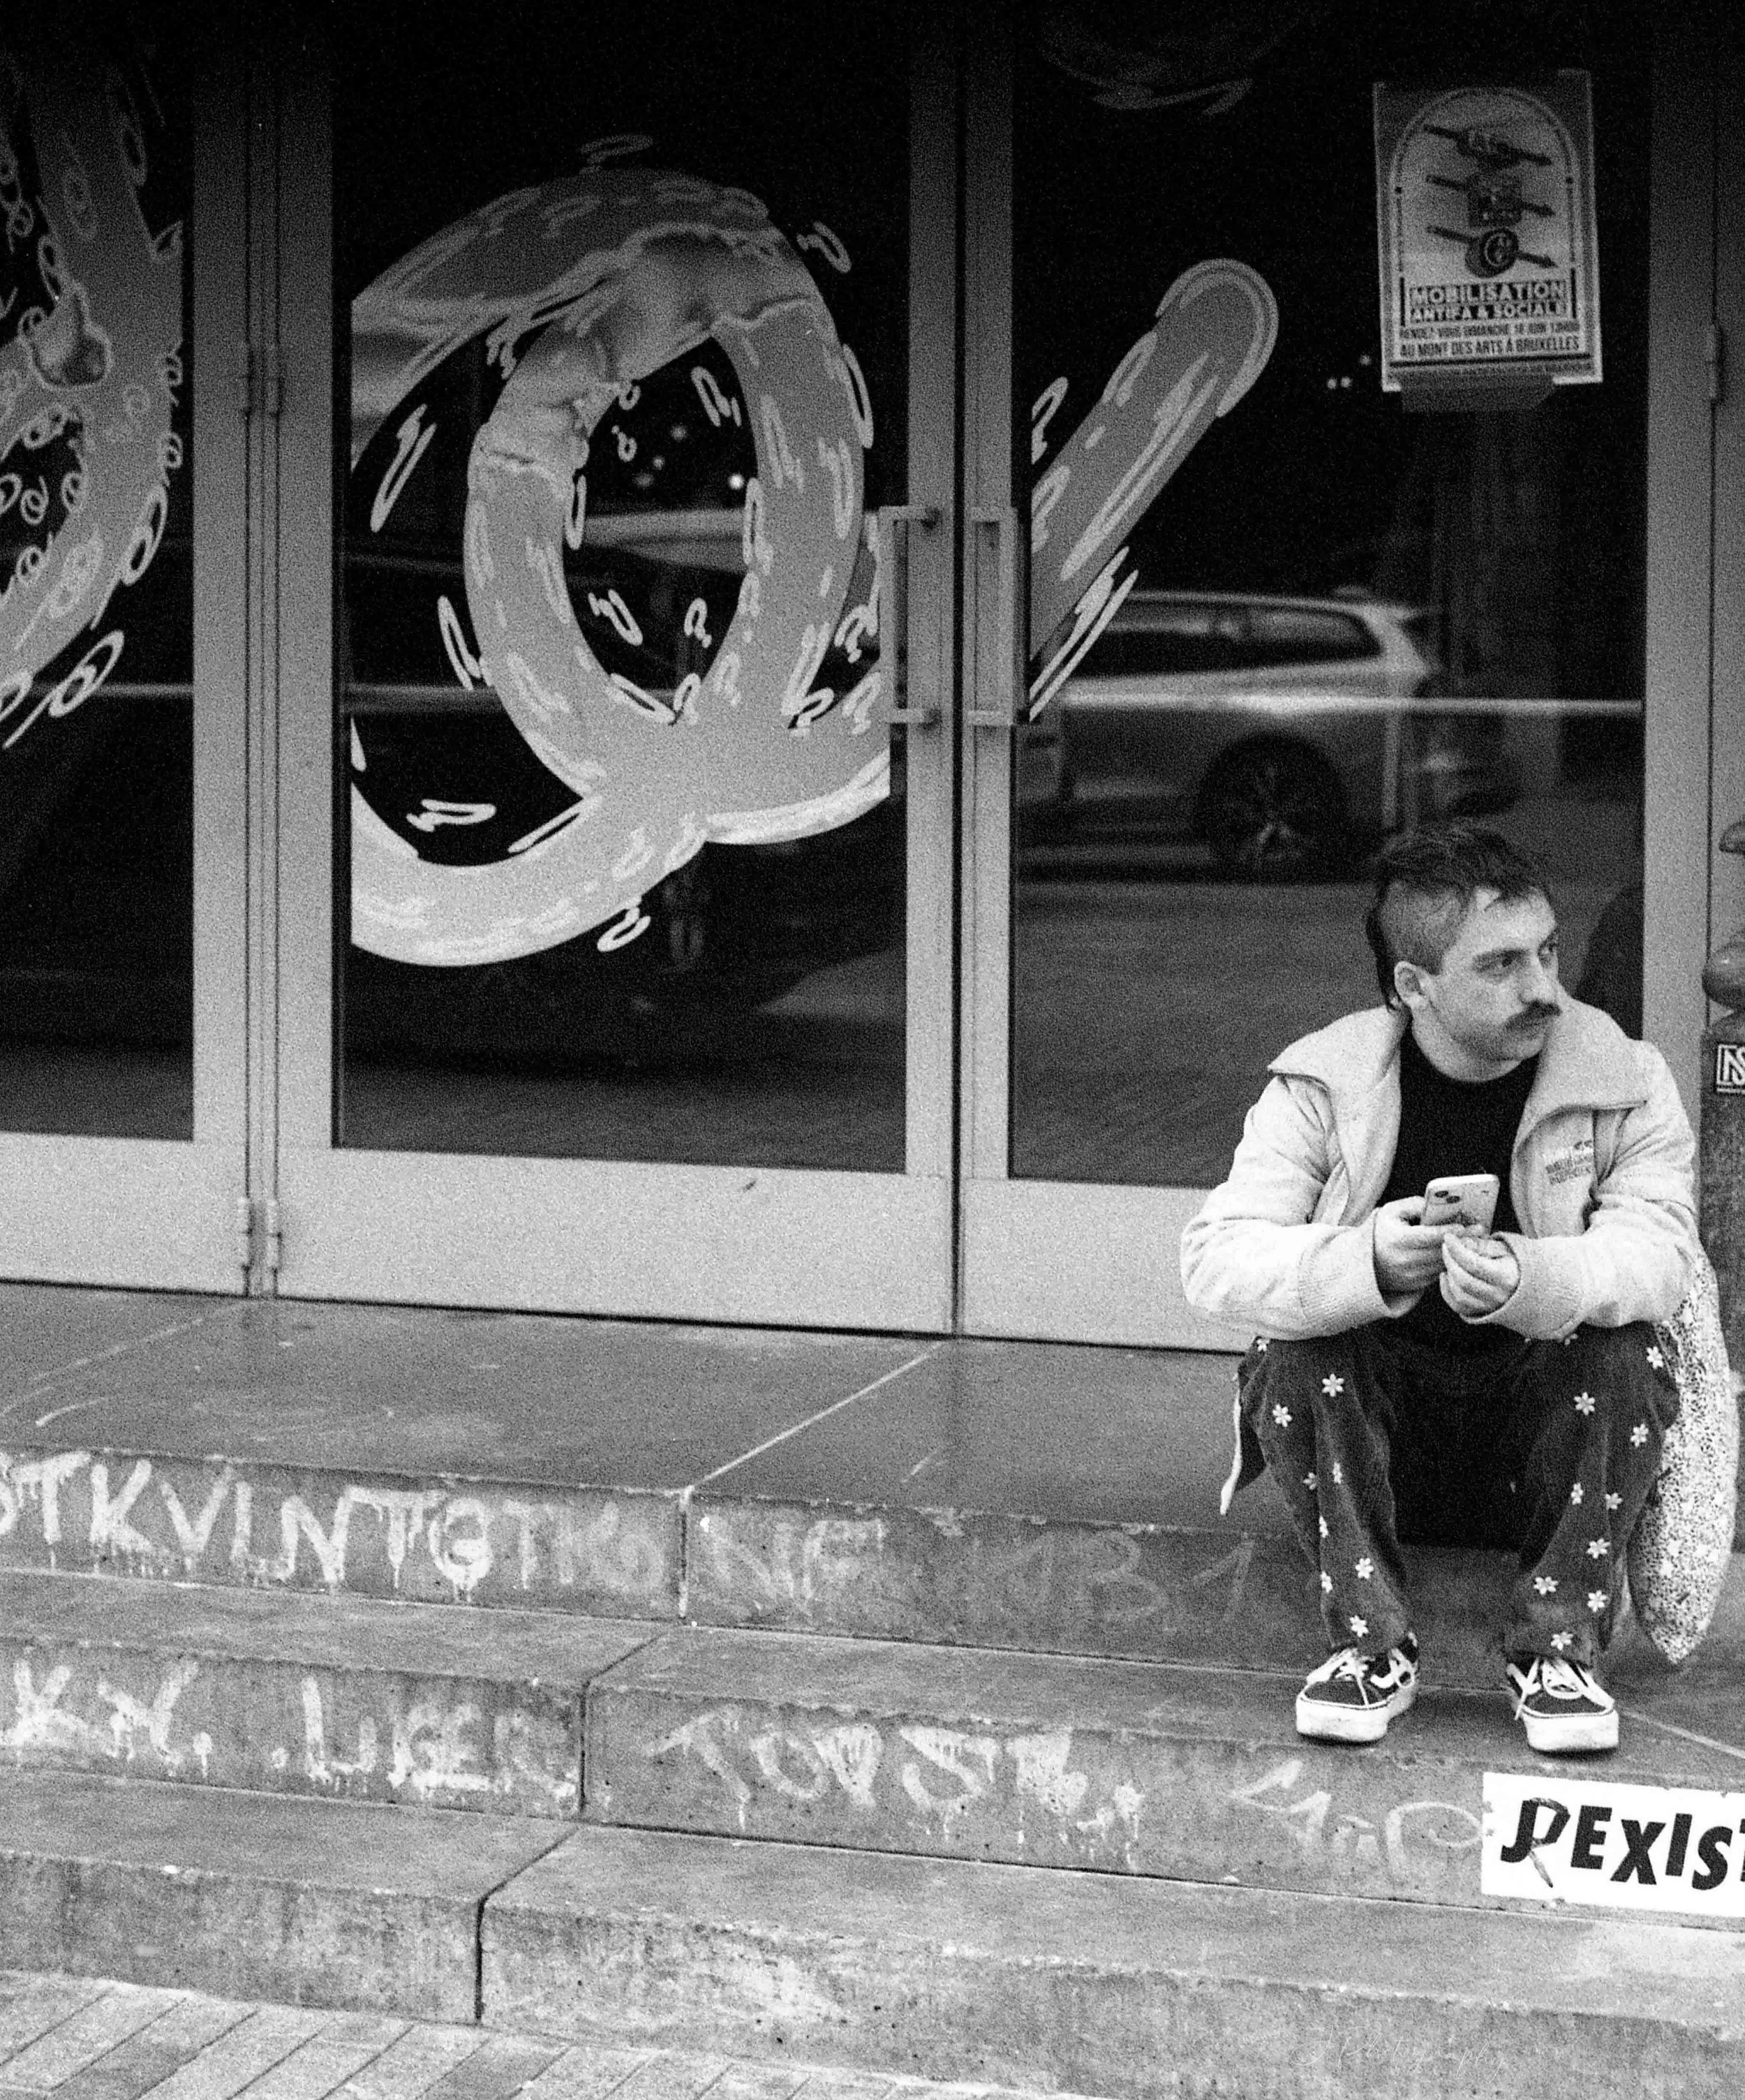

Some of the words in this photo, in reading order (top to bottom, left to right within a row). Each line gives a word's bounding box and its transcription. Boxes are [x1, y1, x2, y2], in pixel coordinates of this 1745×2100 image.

[1411, 282, 1566, 305] MOBILISATION
[1412, 305, 1472, 322] ANTIFA
[1476, 339, 1503, 354] ARTS
[1515, 336, 1580, 352] BRUXELLES
